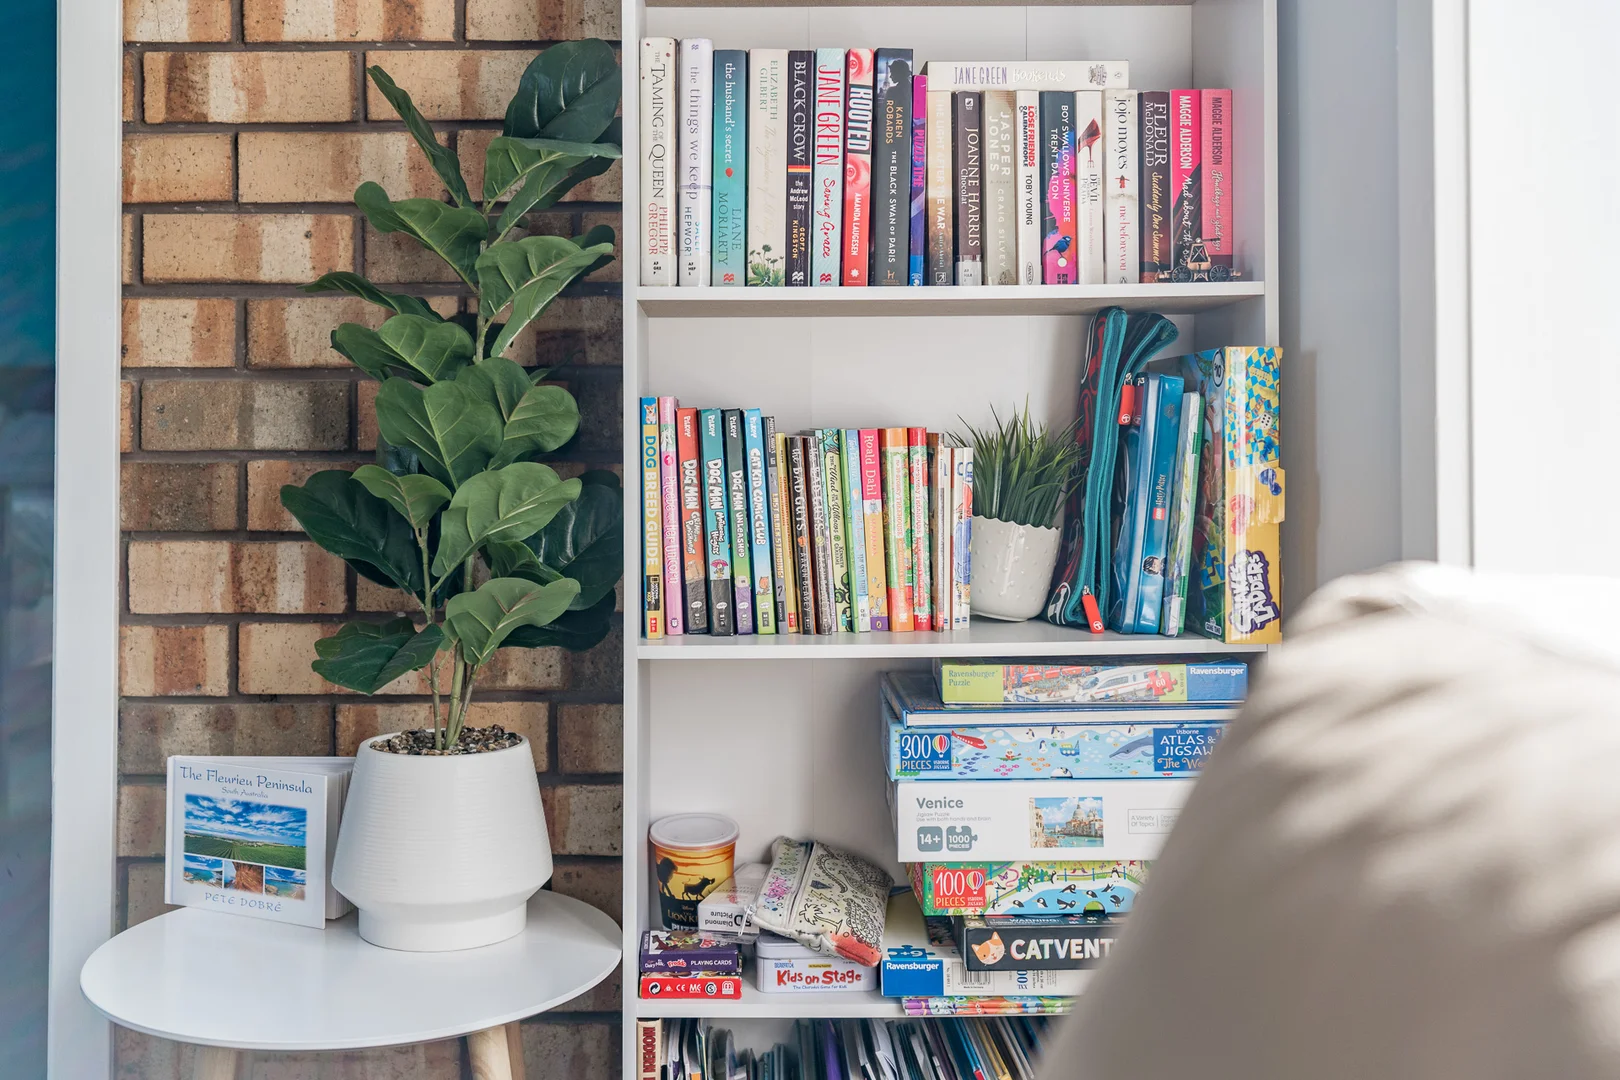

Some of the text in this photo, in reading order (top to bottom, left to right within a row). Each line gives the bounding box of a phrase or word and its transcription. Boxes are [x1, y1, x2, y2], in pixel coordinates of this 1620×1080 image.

[770, 60, 778, 120] ELIZABETH
[954, 67, 976, 84] JANE
[980, 67, 1007, 84] GREEN
[1012, 68, 1066, 83] Bookends
[651, 64, 666, 127] TAMING
[794, 61, 806, 161] BLACK CROW
[725, 63, 735, 163] the husband's secret
[847, 87, 872, 151] ROOTED
[885, 100, 894, 144] ROBARDS
[895, 106, 903, 137] KAREN
[686, 67, 701, 200] the things we keep
[989, 116, 999, 172] JONES
[1001, 112, 1010, 175] JASPER
[1114, 97, 1130, 169] jojo moyes
[1145, 102, 1153, 166] McDONALD
[1154, 102, 1167, 166] FLEUR
[1212, 97, 1222, 165] MAGGIE ALDERSON
[817, 65, 840, 258] JANE GREEN Saving Grace
[914, 130, 924, 187] PUZZLE TIME
[1050, 129, 1059, 200] TRENT DALTON
[1061, 126, 1069, 176] SWALLOWS
[1180, 95, 1192, 228] MAGGIE ALDERSON Mad about
[649, 144, 665, 198] QUEEN
[889, 166, 897, 195] BLACK
[936, 121, 945, 229] LIGHT AFTER THE WAR
[960, 169, 968, 204] Chocolat
[965, 127, 980, 246] JOANNE HARRIS
[1062, 179, 1070, 222] UNIVERSE
[1089, 174, 1098, 204] DEVIL
[889, 198, 897, 224] SWAN
[1025, 198, 1033, 225] YOUNG
[1147, 172, 1163, 264] Suddenly One Summer
[718, 192, 728, 265] MORIARTY
[732, 208, 741, 250] LIANE
[851, 223, 860, 255] LAUGESEN
[890, 226, 895, 235] OF
[1119, 206, 1130, 271] me before you
[888, 237, 896, 263] PARIS
[682, 415, 699, 509] PILKEY DOG MAN
[707, 458, 721, 484] DOG
[791, 448, 801, 464] the
[864, 434, 876, 495] Roald Dahl
[731, 470, 743, 491] DOG
[793, 467, 804, 493] BAD
[829, 467, 838, 492] Wind
[646, 436, 658, 565] DOG BREED GUIDE
[708, 486, 723, 509] MAN
[734, 493, 744, 510] MAN
[750, 448, 760, 467] CAT
[755, 522, 766, 544] CLUB
[796, 497, 806, 531] GUYS
[832, 502, 841, 533] Willows
[664, 476, 679, 584] Phoebe Her Unicorn
[772, 494, 784, 578] LAST STANDING!
[1248, 554, 1275, 623] LADDERS
[948, 670, 995, 678] Ravensburger
[948, 679, 970, 687] Puzzle
[1156, 677, 1165, 687] 60
[1190, 666, 1244, 676] Ravensburger
[901, 736, 931, 758] 300
[1160, 735, 1204, 745] ATLAS
[902, 760, 931, 769] PIECES
[1158, 758, 1180, 769] The
[180, 766, 312, 794] The Fleurieu Peninsula
[222, 786, 268, 799] South Australia
[917, 797, 963, 808] Venice
[919, 834, 941, 844] 14+
[948, 835, 969, 844] 1000
[205, 892, 235, 905] PETE
[936, 871, 964, 896] 100
[668, 910, 687, 921] LION
[936, 897, 965, 906] PIECES
[705, 919, 733, 927] Diamond
[1011, 938, 1120, 959] CATVENT
[777, 970, 862, 986] Kids on Stage
[886, 962, 939, 971] Ravensburger
[643, 1027, 656, 1073] MODERN
